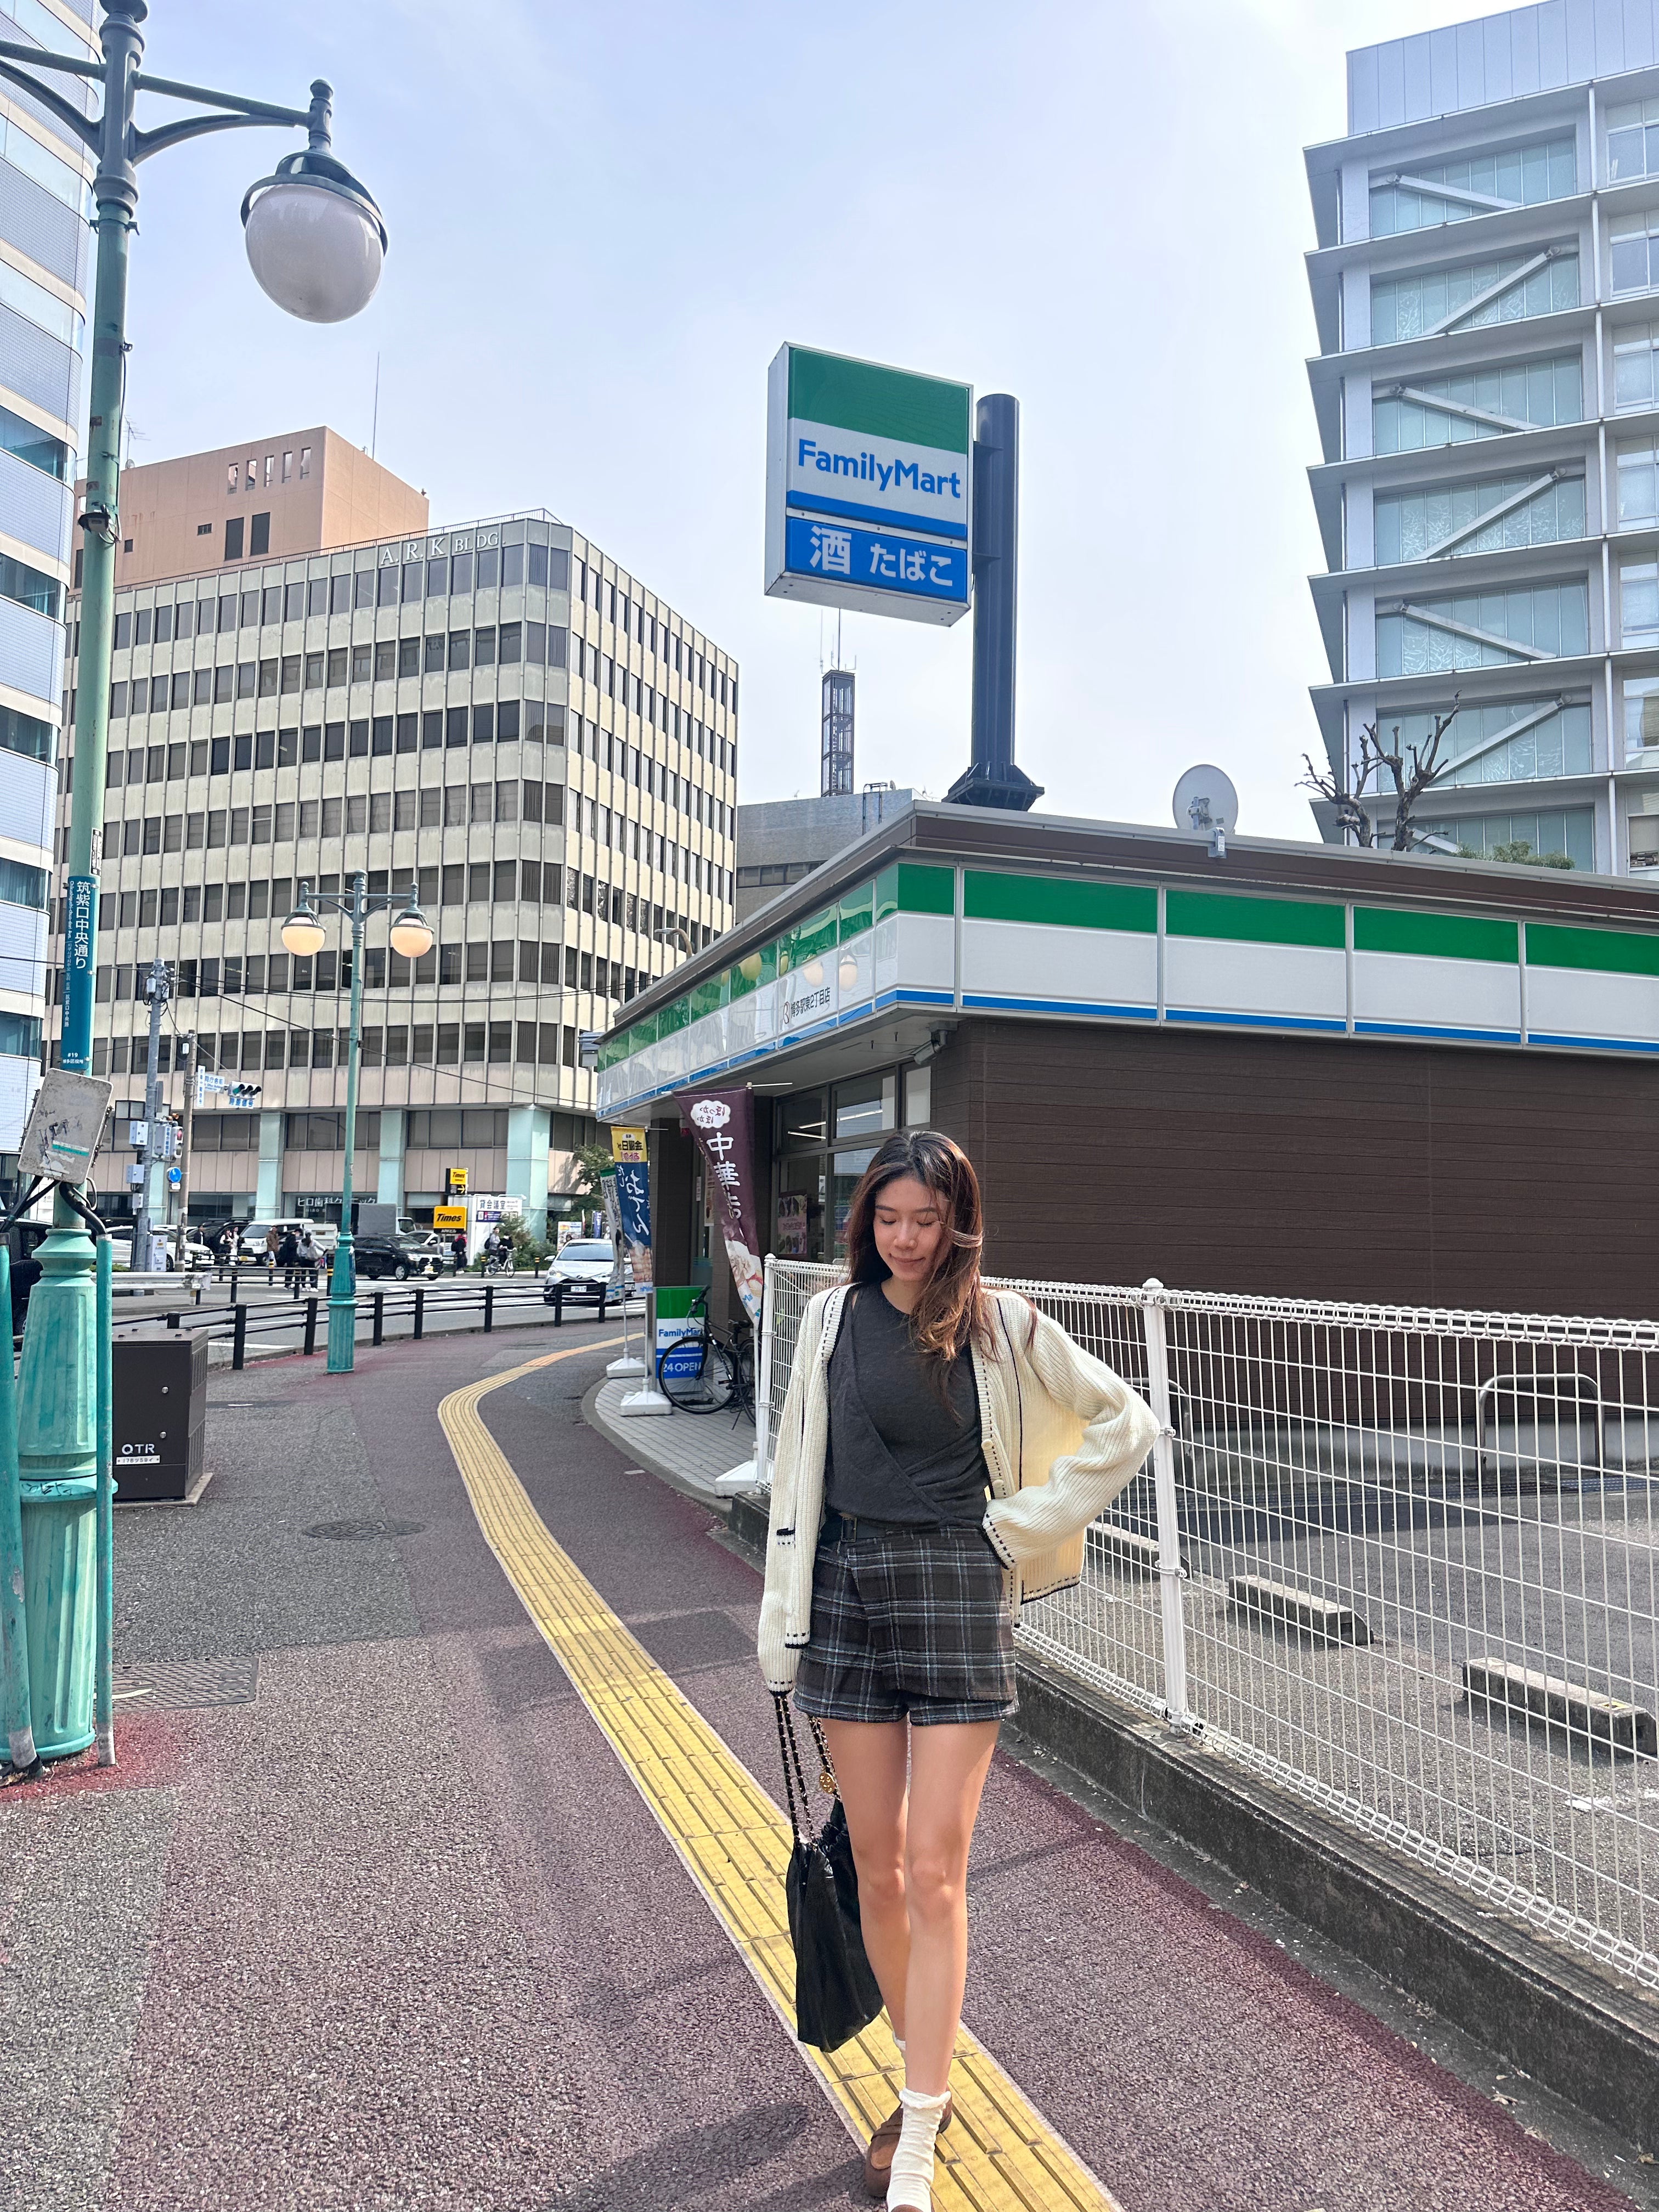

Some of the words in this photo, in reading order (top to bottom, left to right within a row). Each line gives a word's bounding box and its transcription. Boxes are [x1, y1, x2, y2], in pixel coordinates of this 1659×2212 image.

[798, 438, 961, 499] FamilyMart
[809, 525, 851, 575] 酒
[870, 543, 953, 587] たばこ
[74, 881, 91, 969] 筑紫口中央通り
[791, 987, 831, 1019] 博多駅東2丁目店
[436, 1213, 462, 1222] Times
[121, 1443, 155, 1455] QTR
